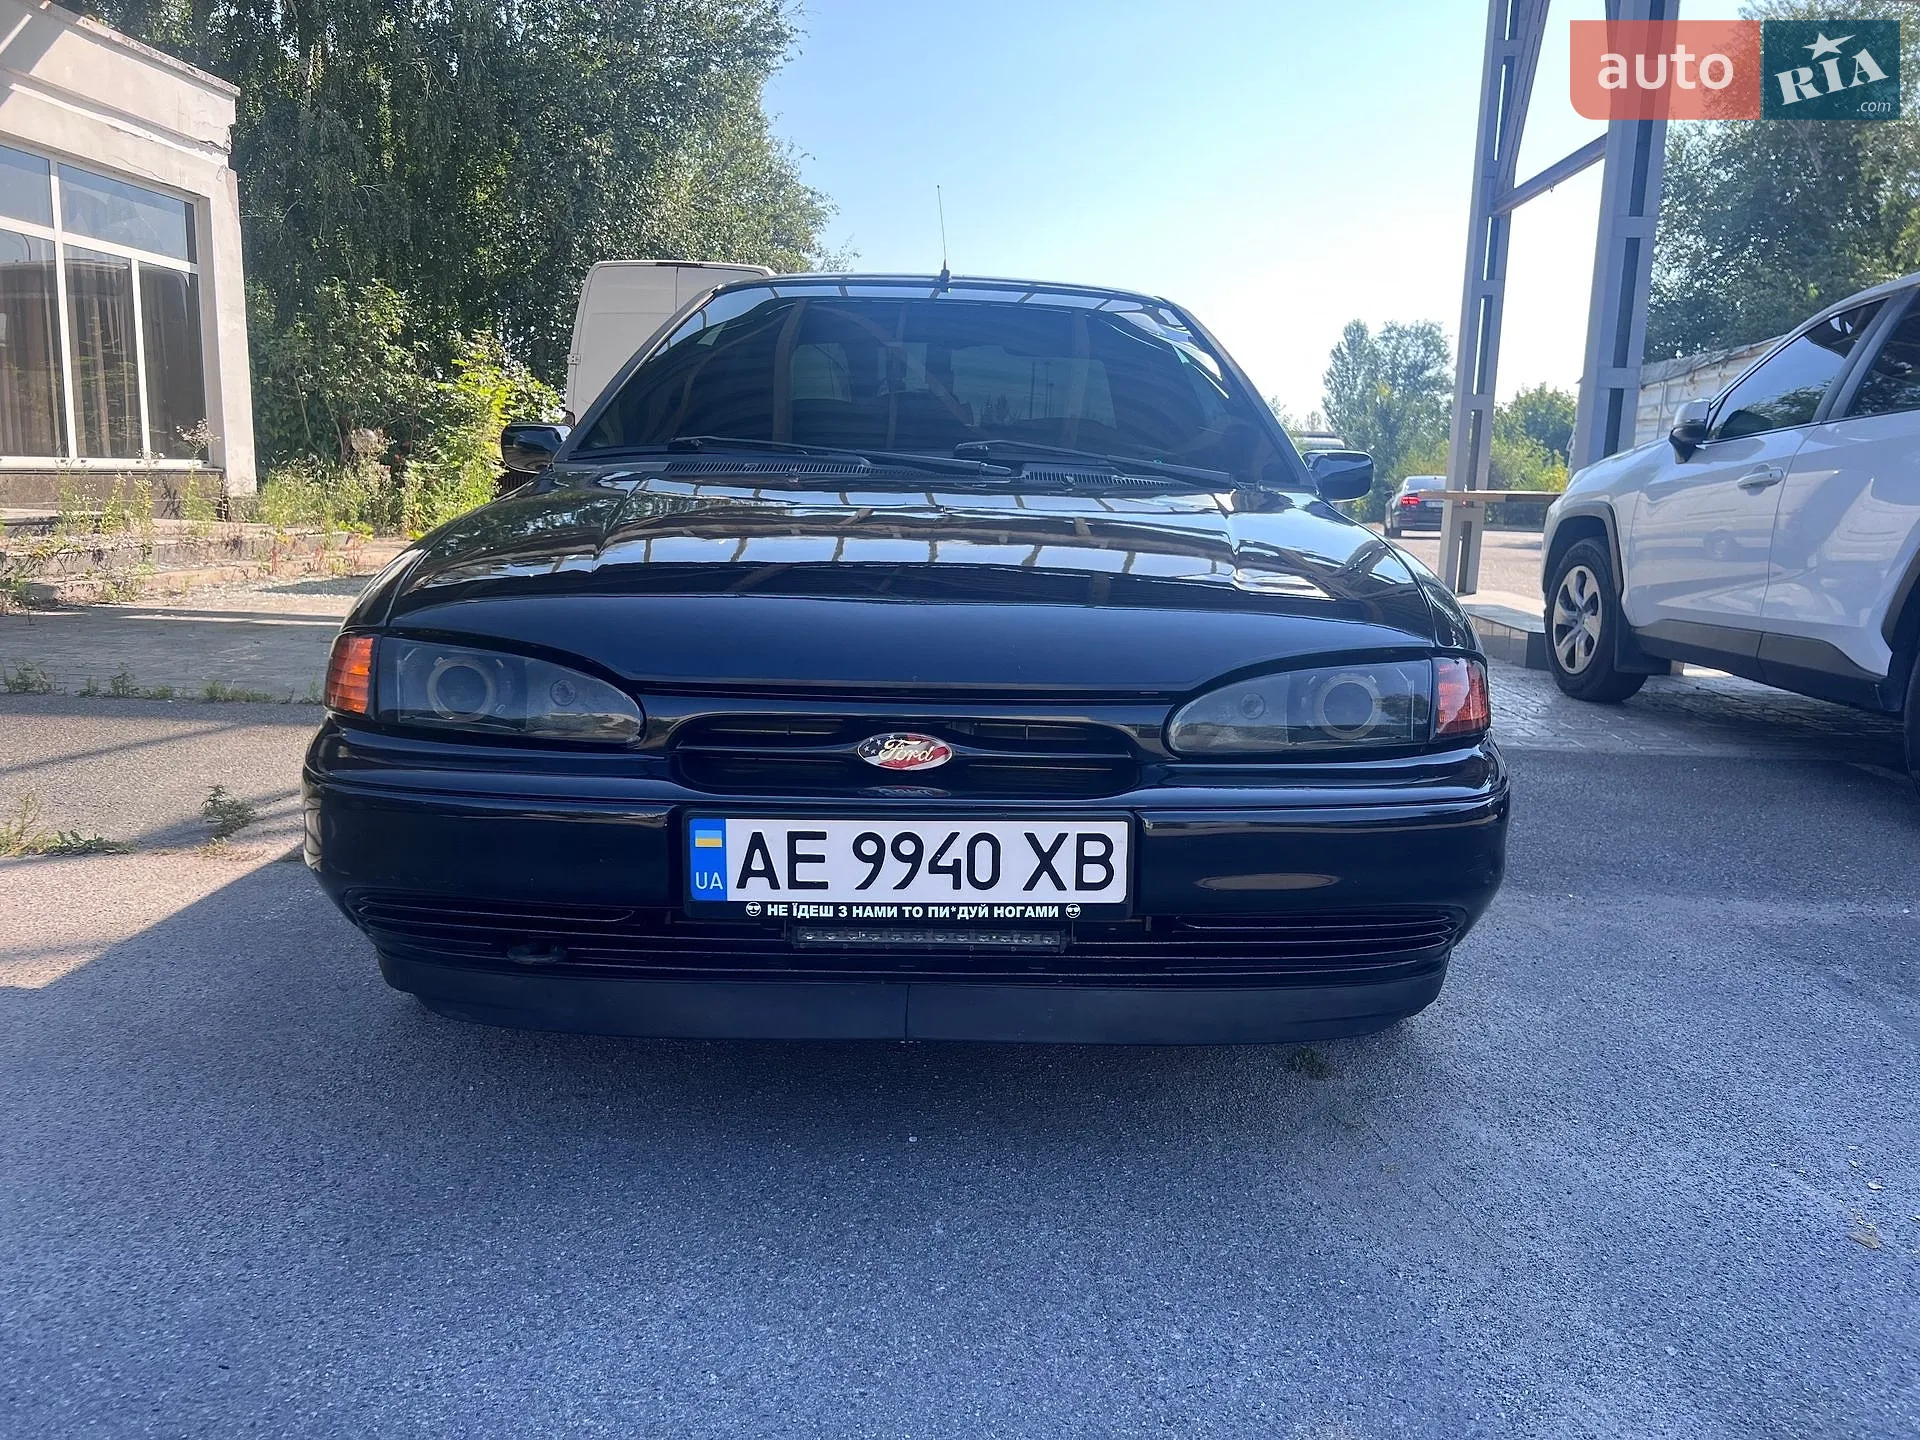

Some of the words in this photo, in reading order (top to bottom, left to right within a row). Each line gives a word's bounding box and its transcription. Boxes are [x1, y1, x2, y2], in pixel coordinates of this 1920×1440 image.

[878, 739, 935, 761] Ford
[735, 831, 829, 891] AE
[852, 831, 1001, 891] 9940
[1022, 832, 1115, 892] XB
[695, 872, 724, 890] UA
[767, 904, 788, 916] НЕ
[792, 902, 834, 918] ЇДЕШ
[852, 905, 898, 917] НАМИ
[902, 906, 923, 918] ТО
[993, 905, 1058, 918] НОГАМИ
